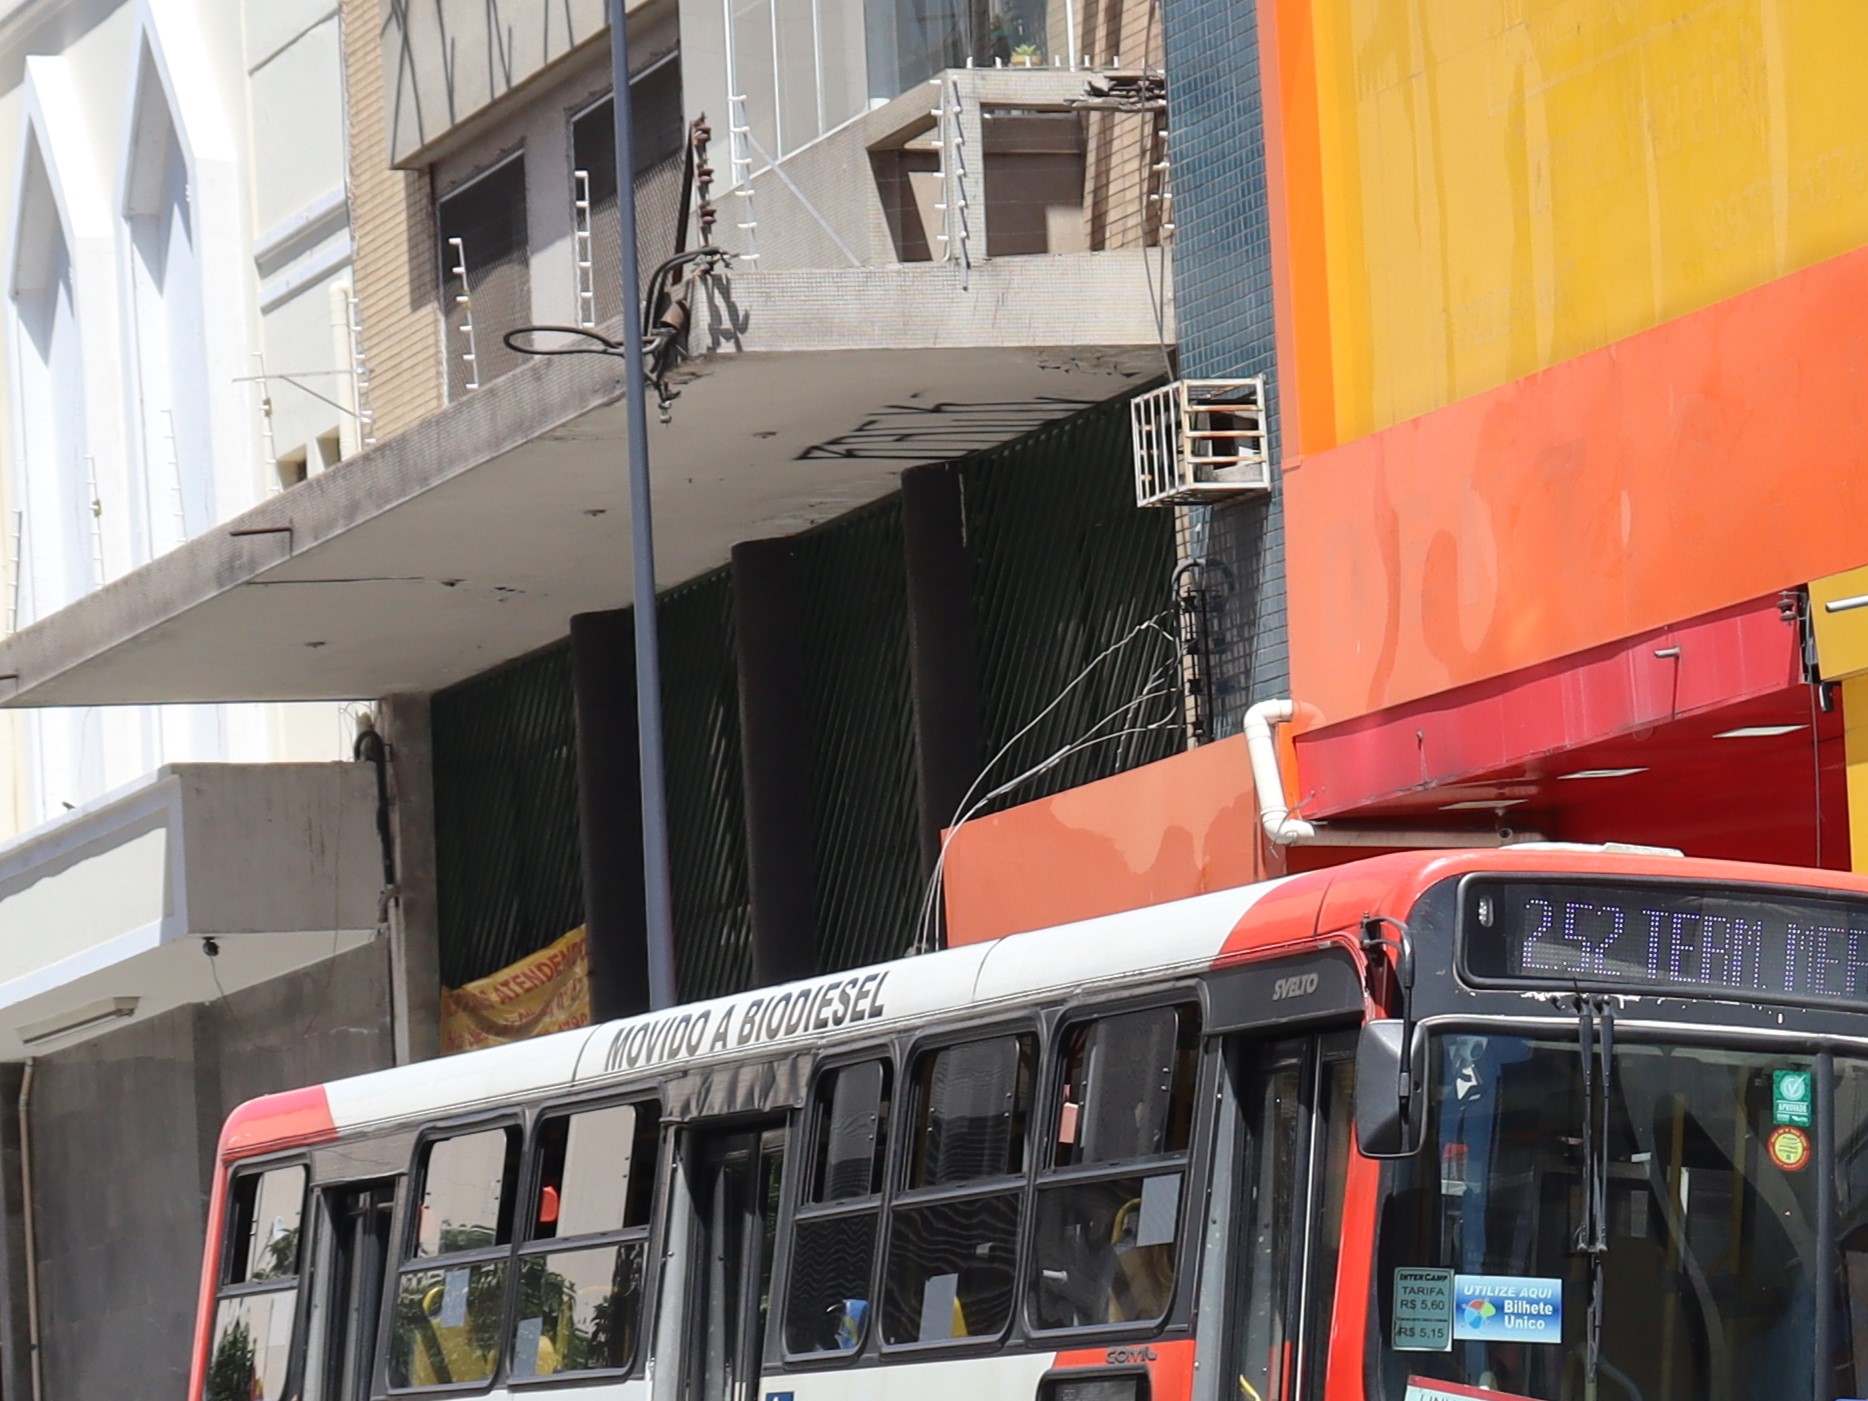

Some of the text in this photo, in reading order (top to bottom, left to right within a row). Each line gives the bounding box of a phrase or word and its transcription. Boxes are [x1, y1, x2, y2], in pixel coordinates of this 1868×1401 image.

[1522, 898, 1624, 975] 252
[1272, 973, 1319, 1000] SVELTO
[605, 1010, 711, 1072] MOVIDO
[710, 1003, 734, 1053] A
[736, 970, 891, 1047] BIODIESEL
[1402, 1286, 1445, 1297] TARIFA
[1464, 1285, 1552, 1299] UTILIZE AQUI
[1401, 1300, 1445, 1311] R$ 5,60
[1504, 1300, 1553, 1315] Bilhete
[1401, 1327, 1444, 1339] R$ 5,15
[1106, 1346, 1157, 1364] COMIL
